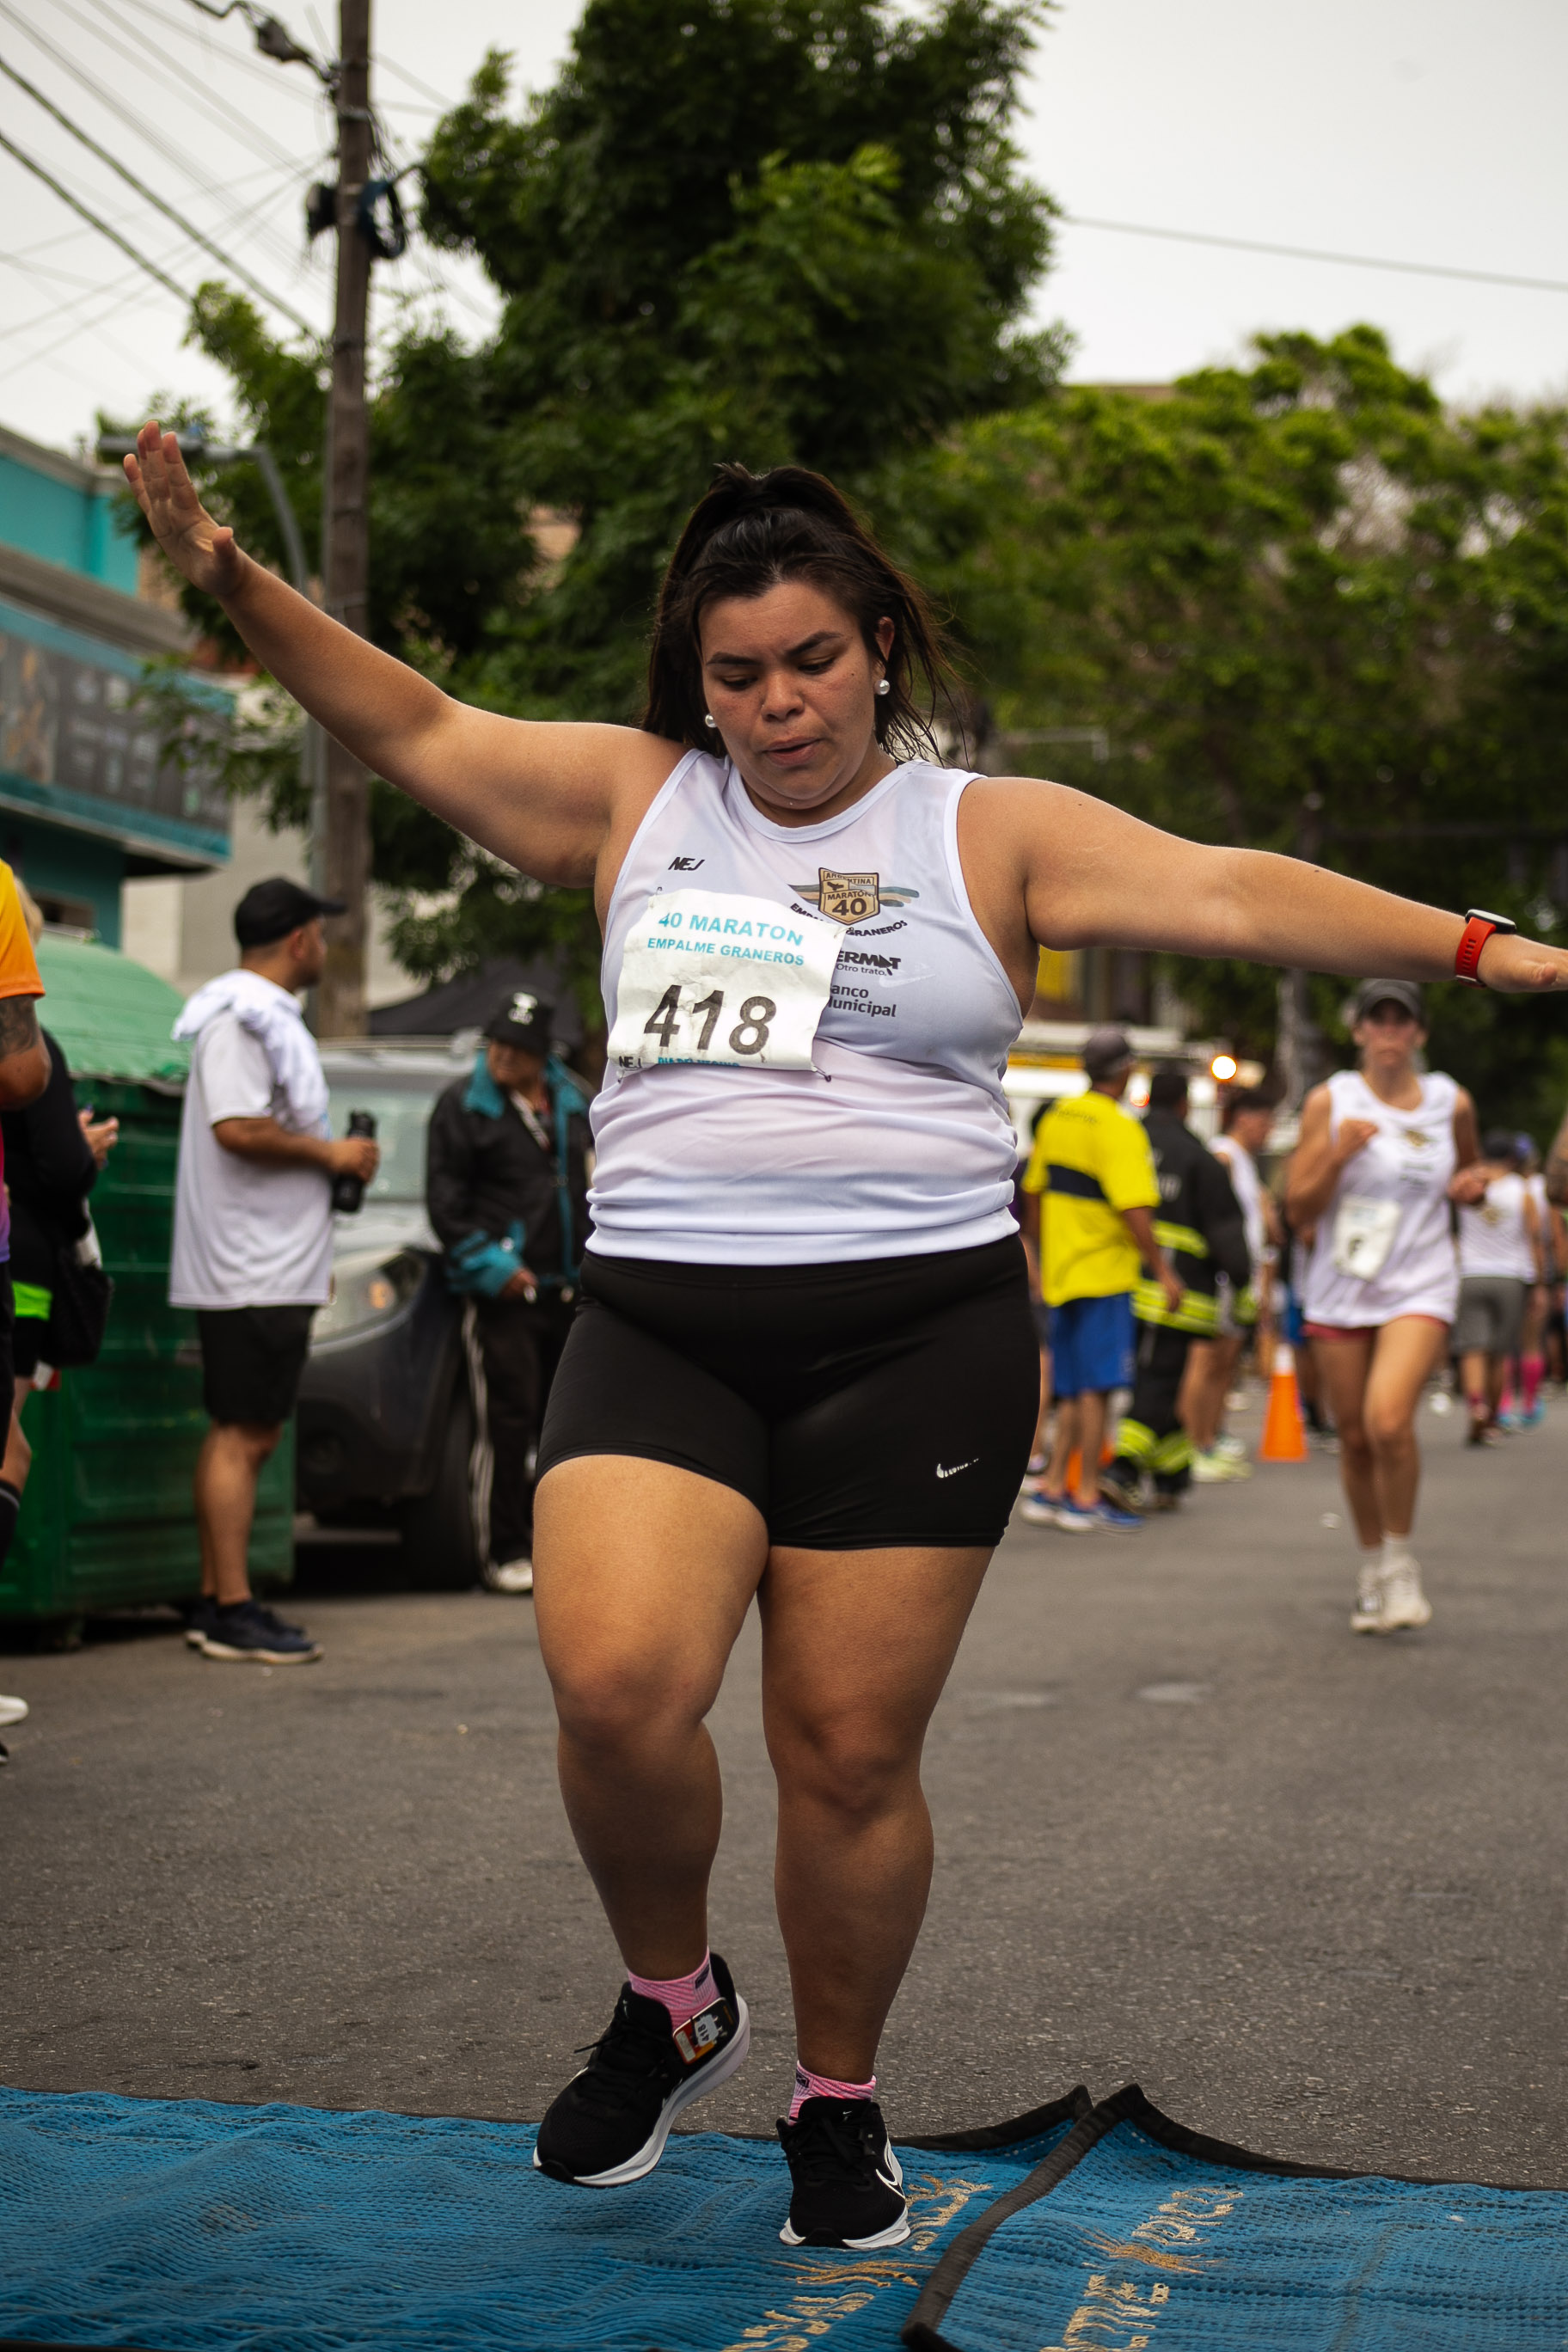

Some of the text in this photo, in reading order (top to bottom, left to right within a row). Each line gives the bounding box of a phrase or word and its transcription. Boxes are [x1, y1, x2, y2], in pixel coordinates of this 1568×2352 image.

[668, 856, 705, 871] NEJ
[832, 898, 867, 916] 40
[658, 912, 804, 946] 40 MARATON
[846, 920, 908, 937] GRANEROS
[647, 937, 805, 966] EMPALME GRANEROS
[836, 950, 901, 970] ERMAT
[836, 963, 859, 972] Otro
[830, 984, 869, 998] anco
[644, 984, 777, 1056] 418
